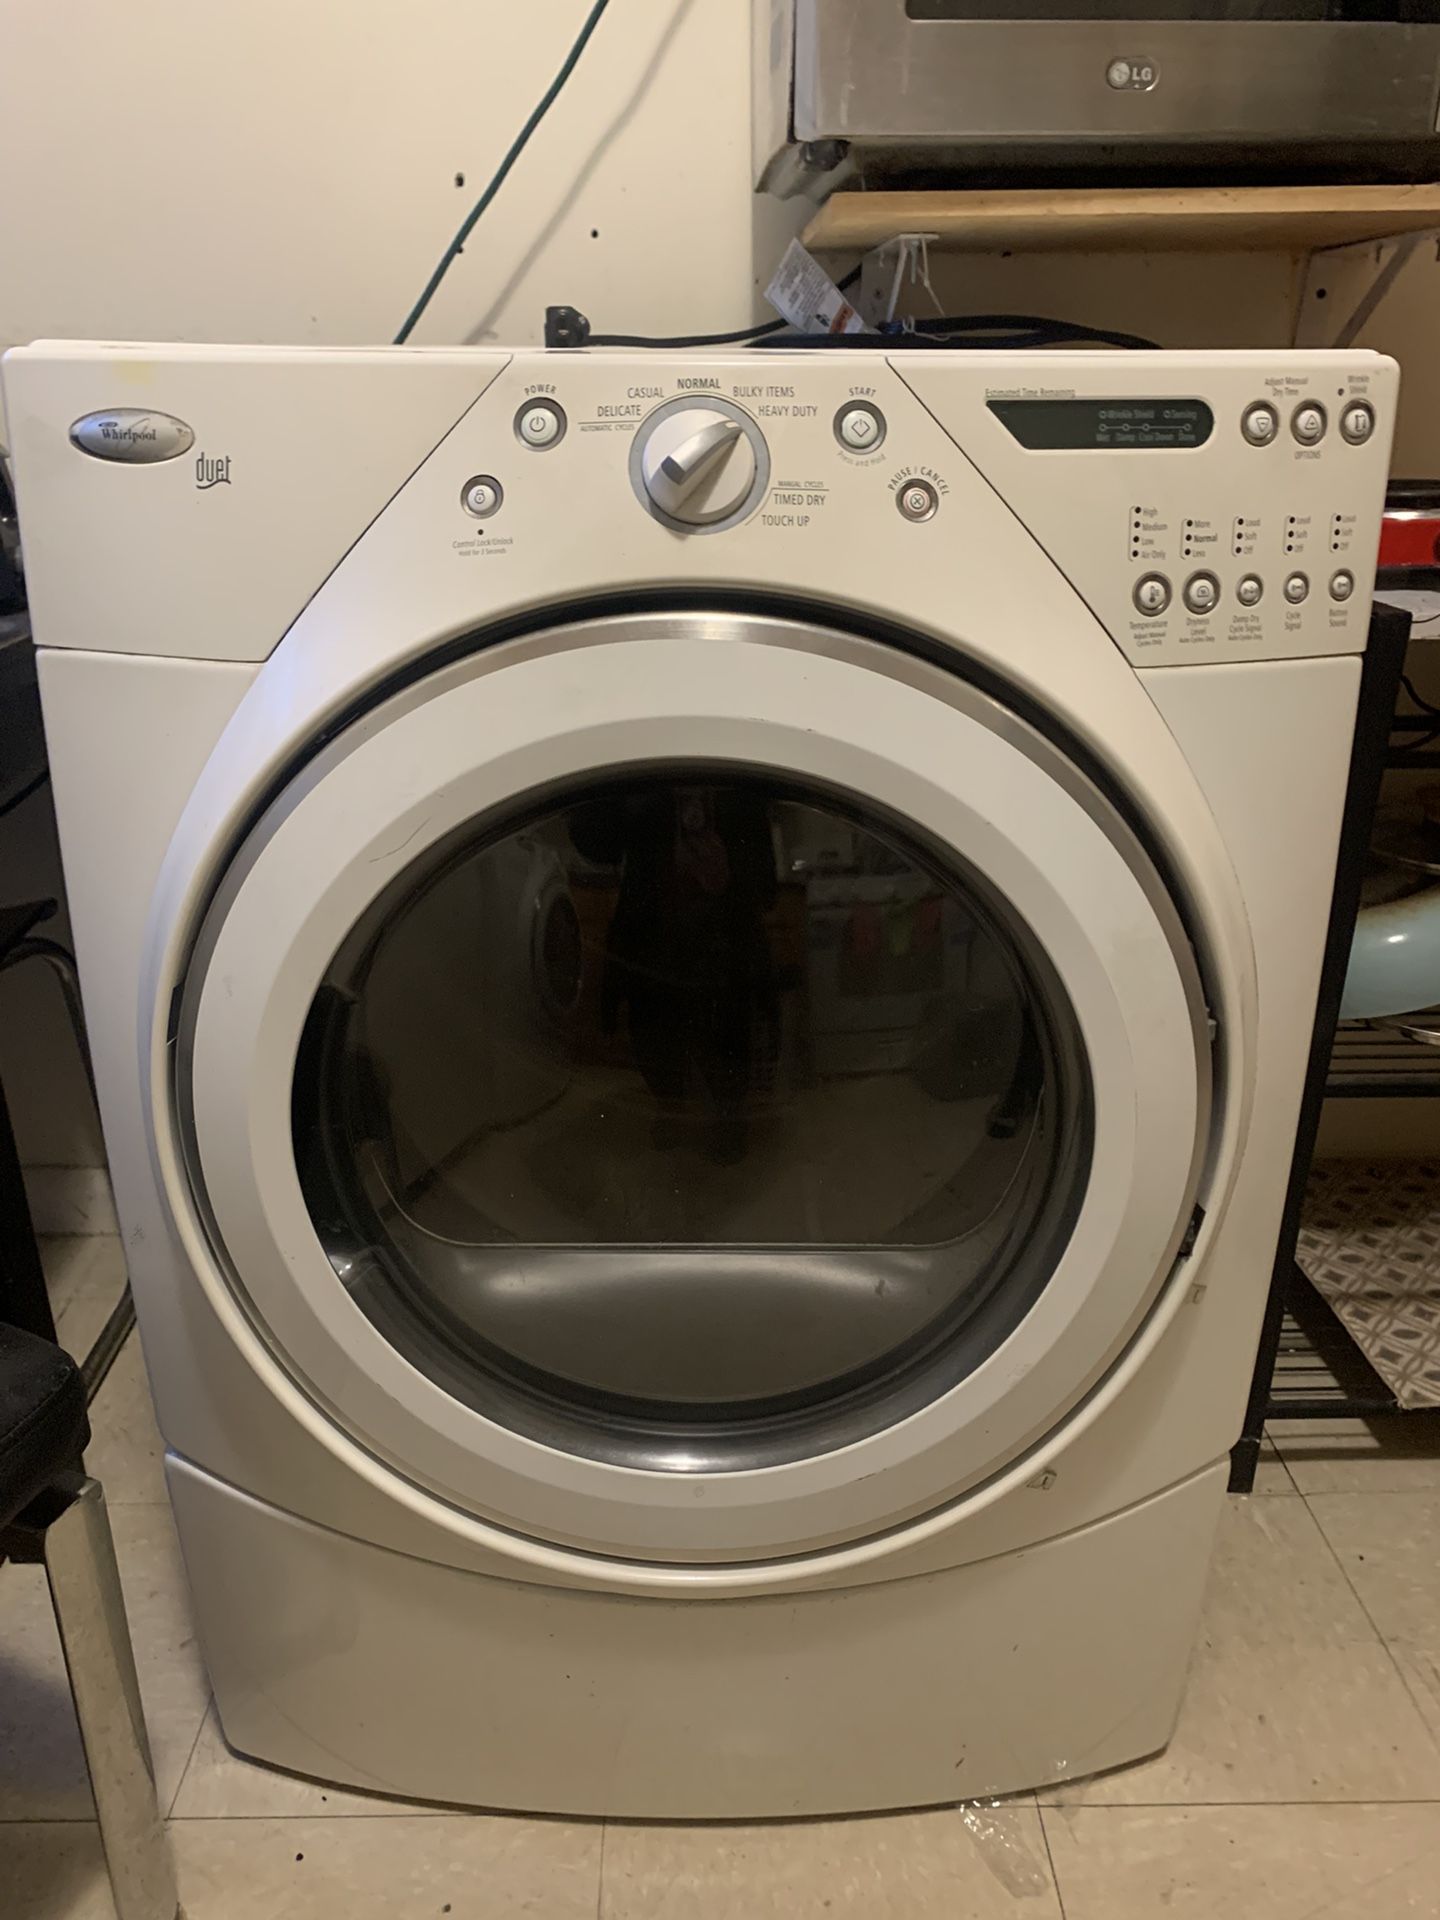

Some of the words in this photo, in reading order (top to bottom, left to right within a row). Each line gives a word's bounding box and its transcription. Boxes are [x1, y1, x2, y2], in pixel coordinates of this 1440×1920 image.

[1132, 67, 1152, 81] LG
[677, 378, 721, 389] NORMAL
[524, 384, 557, 396] POWER
[627, 387, 665, 399] CASUAL
[733, 386, 763, 398] BULKY
[766, 386, 795, 398] ITEMS
[848, 386, 876, 398] START
[597, 404, 642, 417] DELICATE
[758, 405, 789, 417] HEAVY
[792, 406, 818, 417] DUTY
[580, 423, 612, 432] AUTOMATIC
[101, 428, 157, 443] Whirlpool
[195, 452, 232, 486] duet
[887, 466, 912, 491] PAUSE
[920, 466, 950, 496] CANCEL
[774, 493, 804, 505] TIMED
[807, 494, 826, 506] DRY
[761, 514, 794, 526] TOUCH
[797, 515, 811, 526] UP
[1193, 533, 1218, 543] Normal
